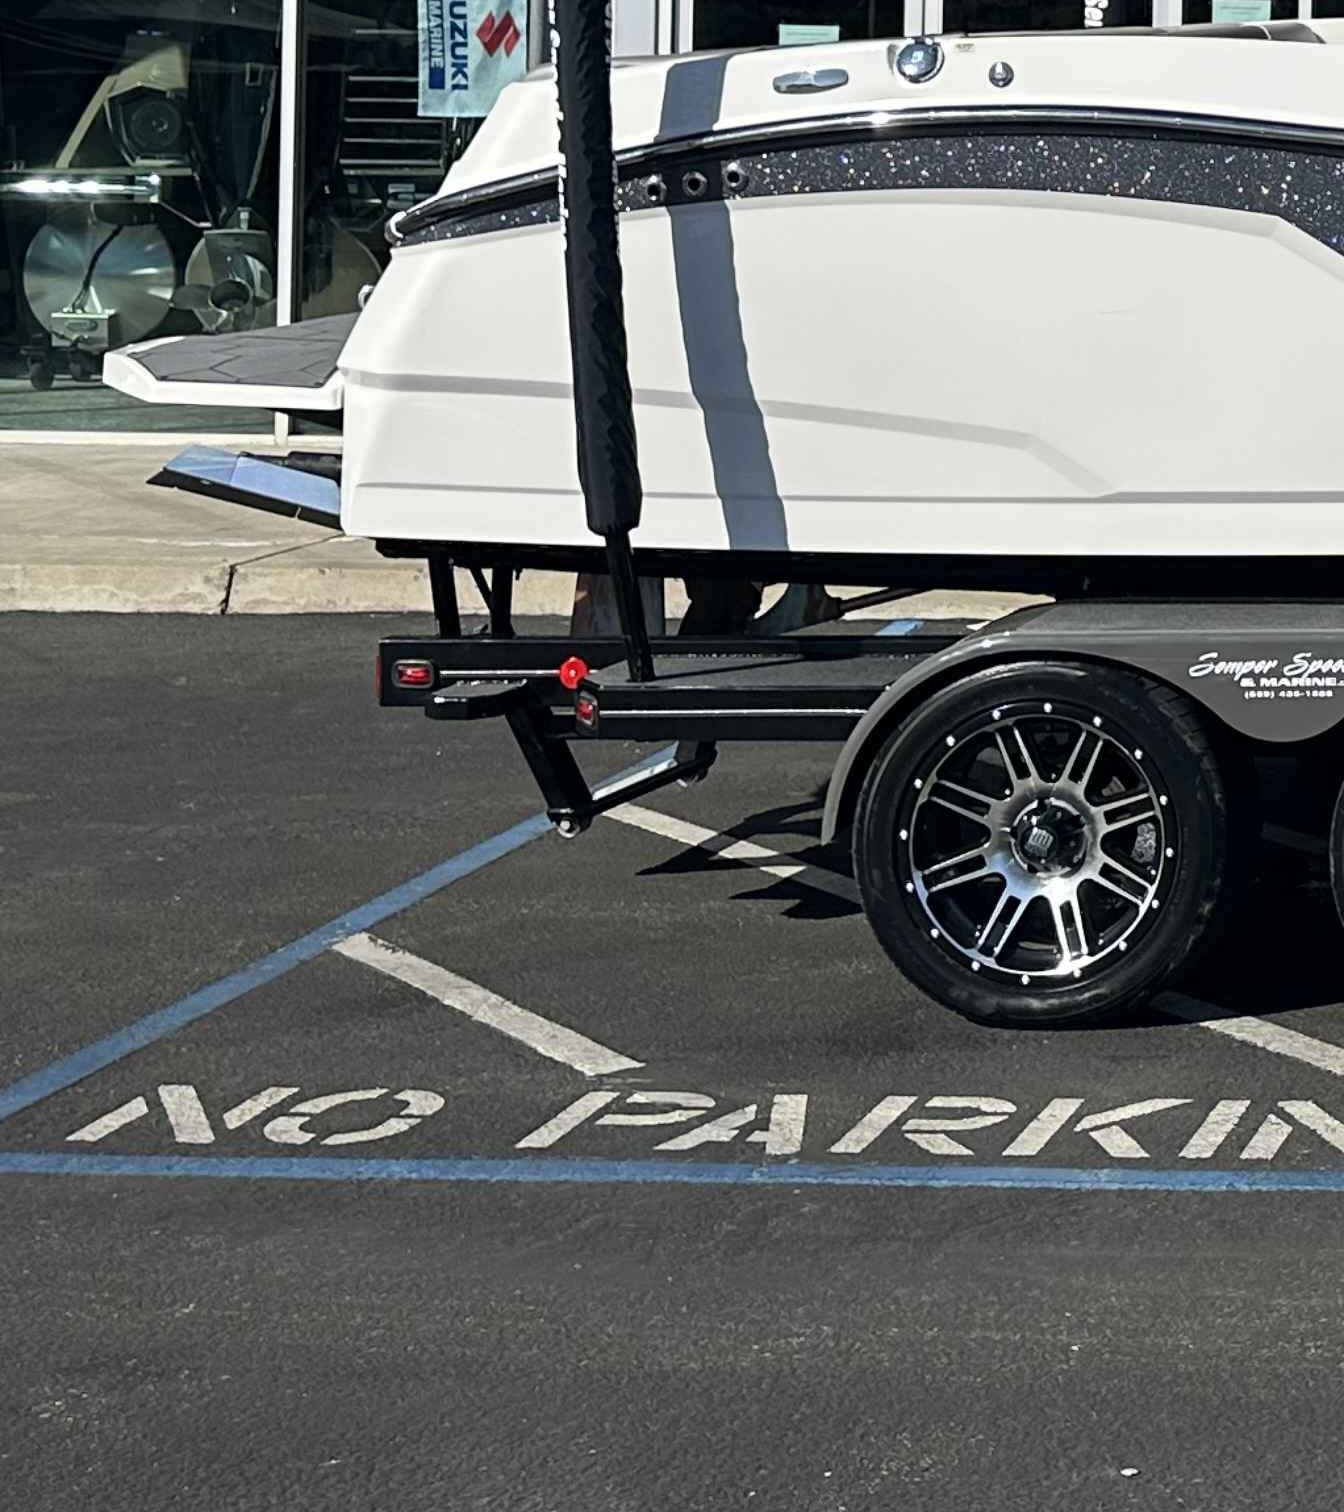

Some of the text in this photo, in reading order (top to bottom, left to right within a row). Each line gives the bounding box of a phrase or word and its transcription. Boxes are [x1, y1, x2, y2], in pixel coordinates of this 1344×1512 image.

[428, 0, 444, 68] MARINE
[1188, 651, 1279, 681] Semper
[65, 1084, 445, 1147] NO
